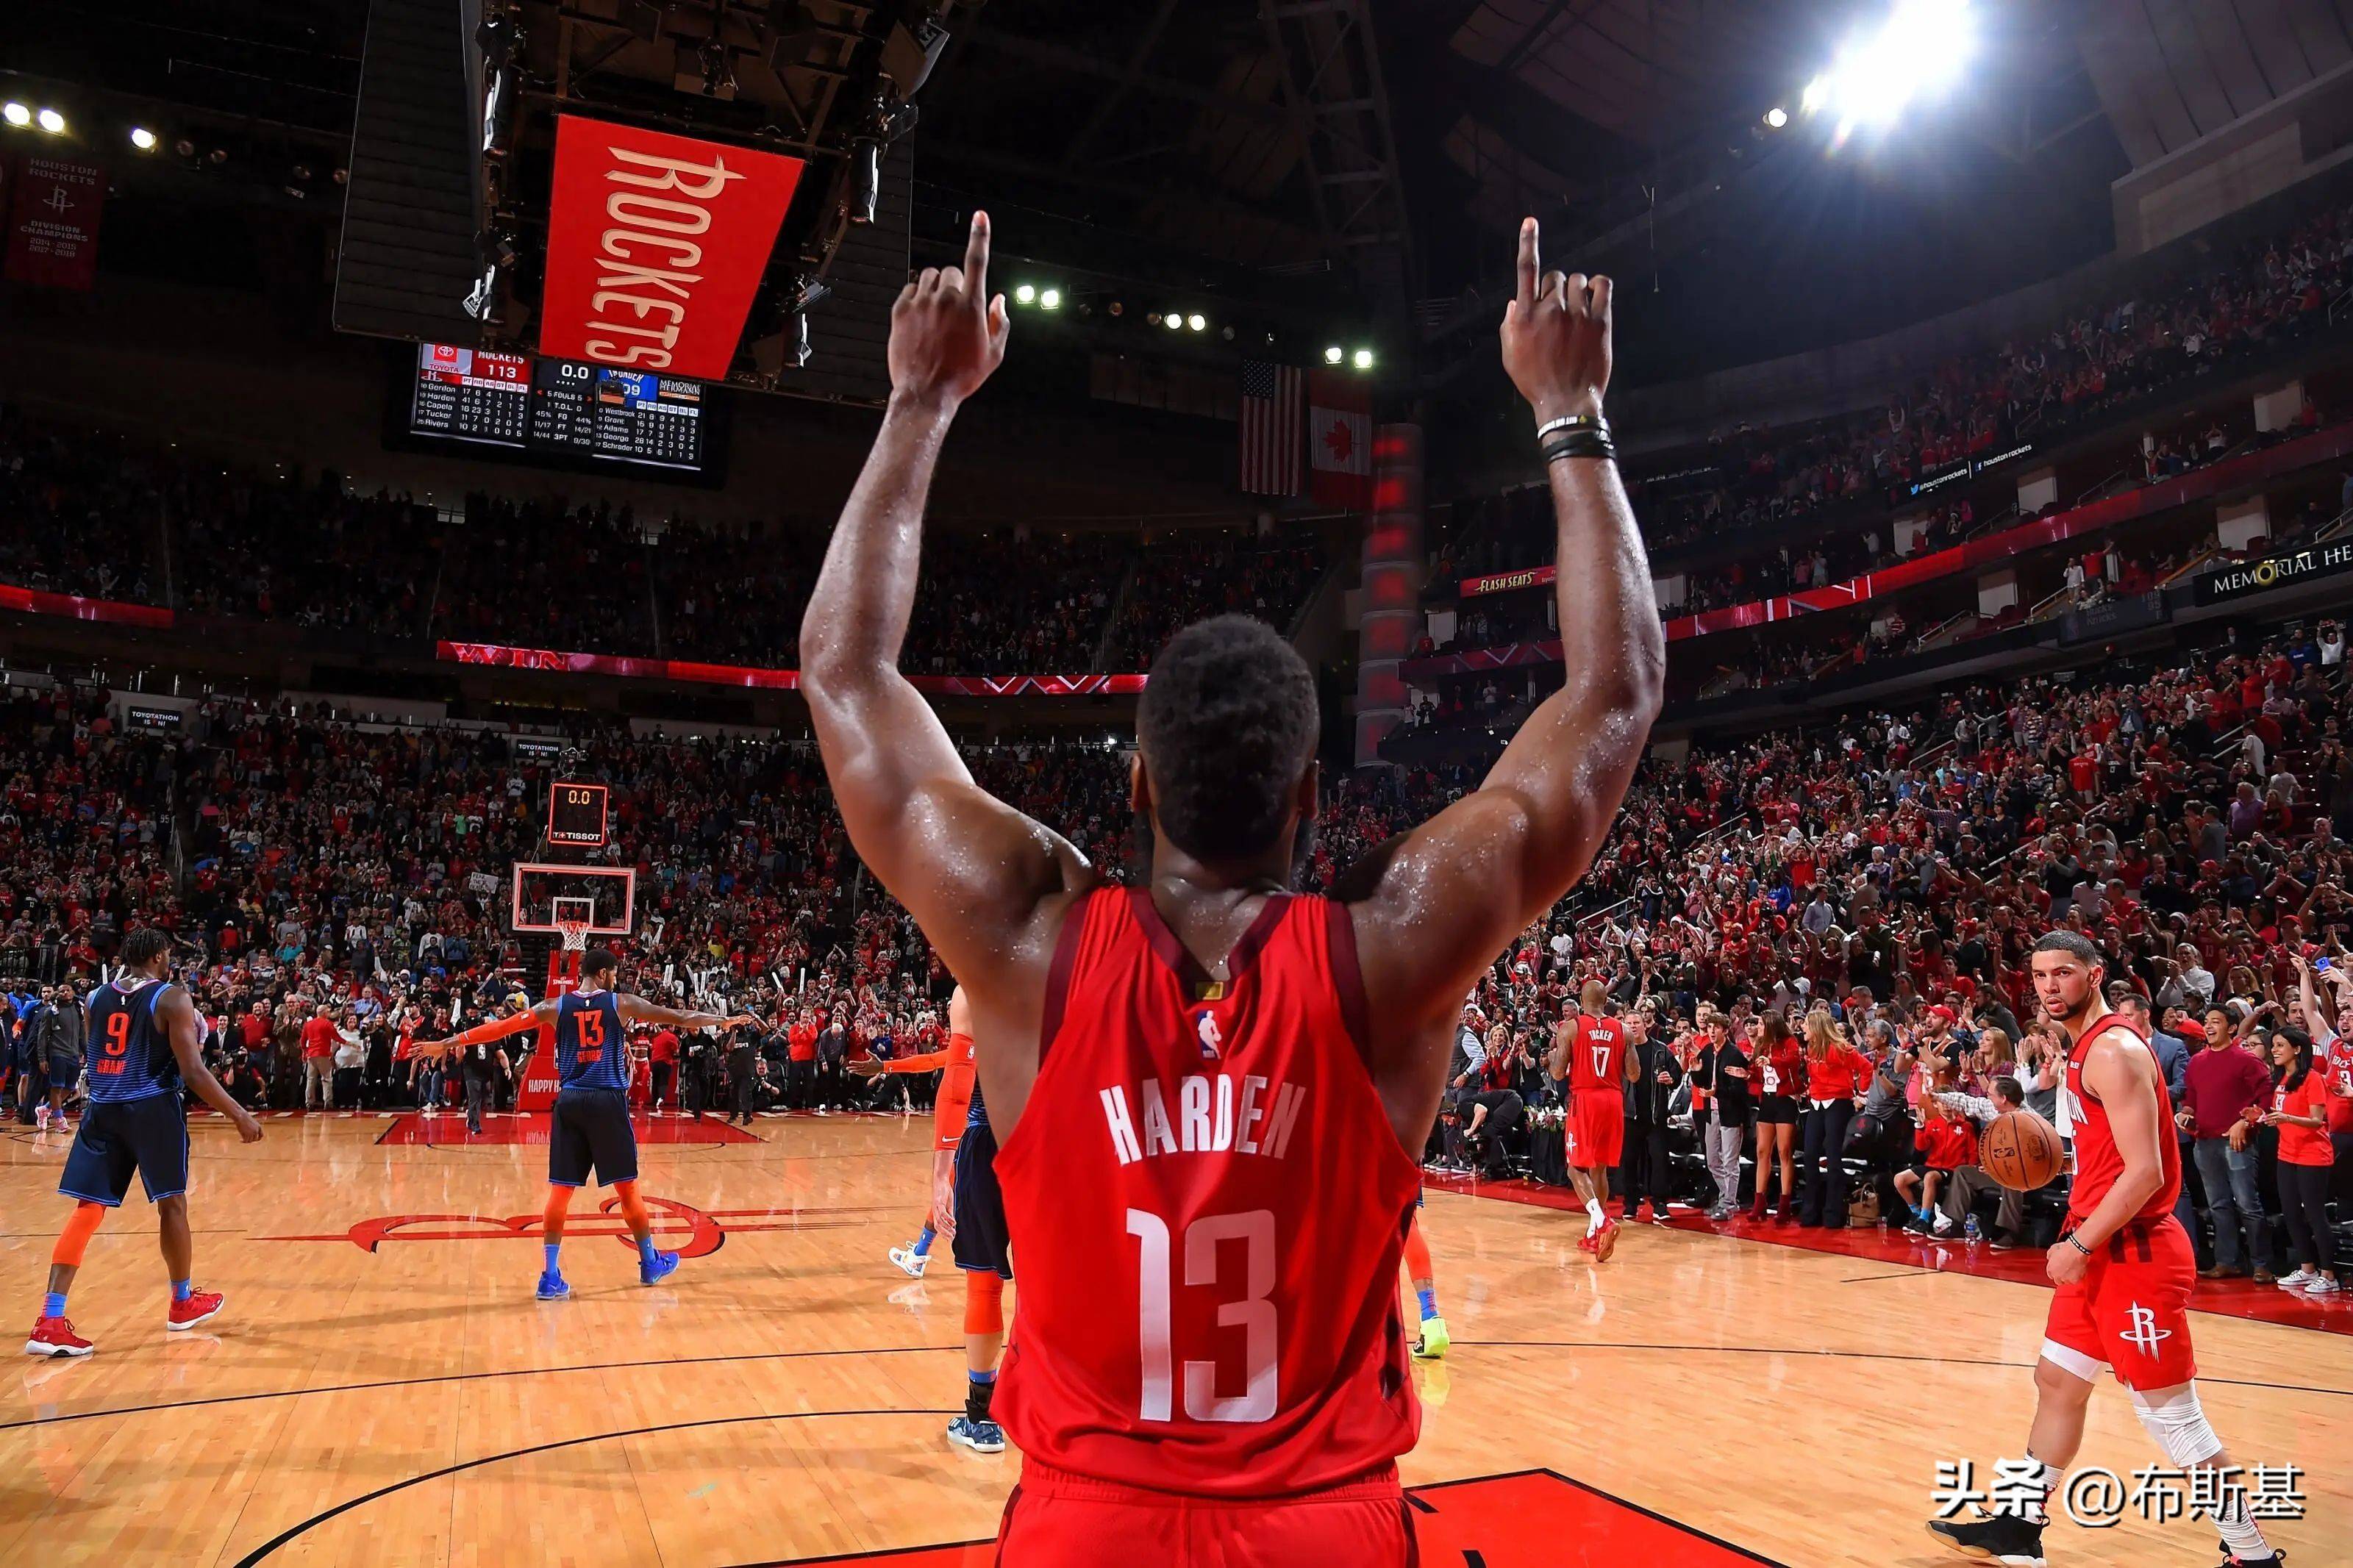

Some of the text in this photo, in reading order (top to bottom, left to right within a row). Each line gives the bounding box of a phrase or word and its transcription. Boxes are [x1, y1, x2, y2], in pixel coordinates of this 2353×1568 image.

[30, 157, 97, 176] HOUSTON
[29, 168, 95, 185] ROCKETS
[21, 225, 88, 242] CHAMPIONS
[31, 221, 81, 234] DIVISION
[585, 146, 747, 368] ROCKETS
[429, 364, 459, 373] TOYOTA
[489, 365, 516, 378] 113
[562, 365, 588, 379] 0.0
[429, 384, 455, 393] Gordon
[427, 393, 455, 402] Harden
[554, 391, 575, 400] FOULS
[426, 401, 452, 410] Capela
[605, 407, 635, 417] Westbrook
[426, 409, 451, 419] Tucker
[604, 416, 624, 424] Grant
[426, 419, 449, 428] Rivers
[604, 425, 629, 433] Adams
[603, 433, 629, 442] George
[1984, 444, 2032, 467] houston rockets
[2214, 554, 2316, 594] MEMORIAL
[1475, 580, 1506, 592] FLASH
[1507, 572, 1538, 587] SEATS
[132, 712, 179, 721] TOYOTATHON
[568, 790, 590, 804] 0.0
[567, 832, 601, 840] TISSOT
[2287, 966, 2298, 981] 15
[105, 1012, 129, 1056] 9
[573, 1009, 604, 1048] 13
[1588, 1029, 1614, 1042] TUCKER
[1591, 1045, 1611, 1078] 17
[529, 1080, 553, 1093] HAPPY
[1099, 1075, 1307, 1167] HARDEN
[1126, 1207, 1279, 1423] 13
